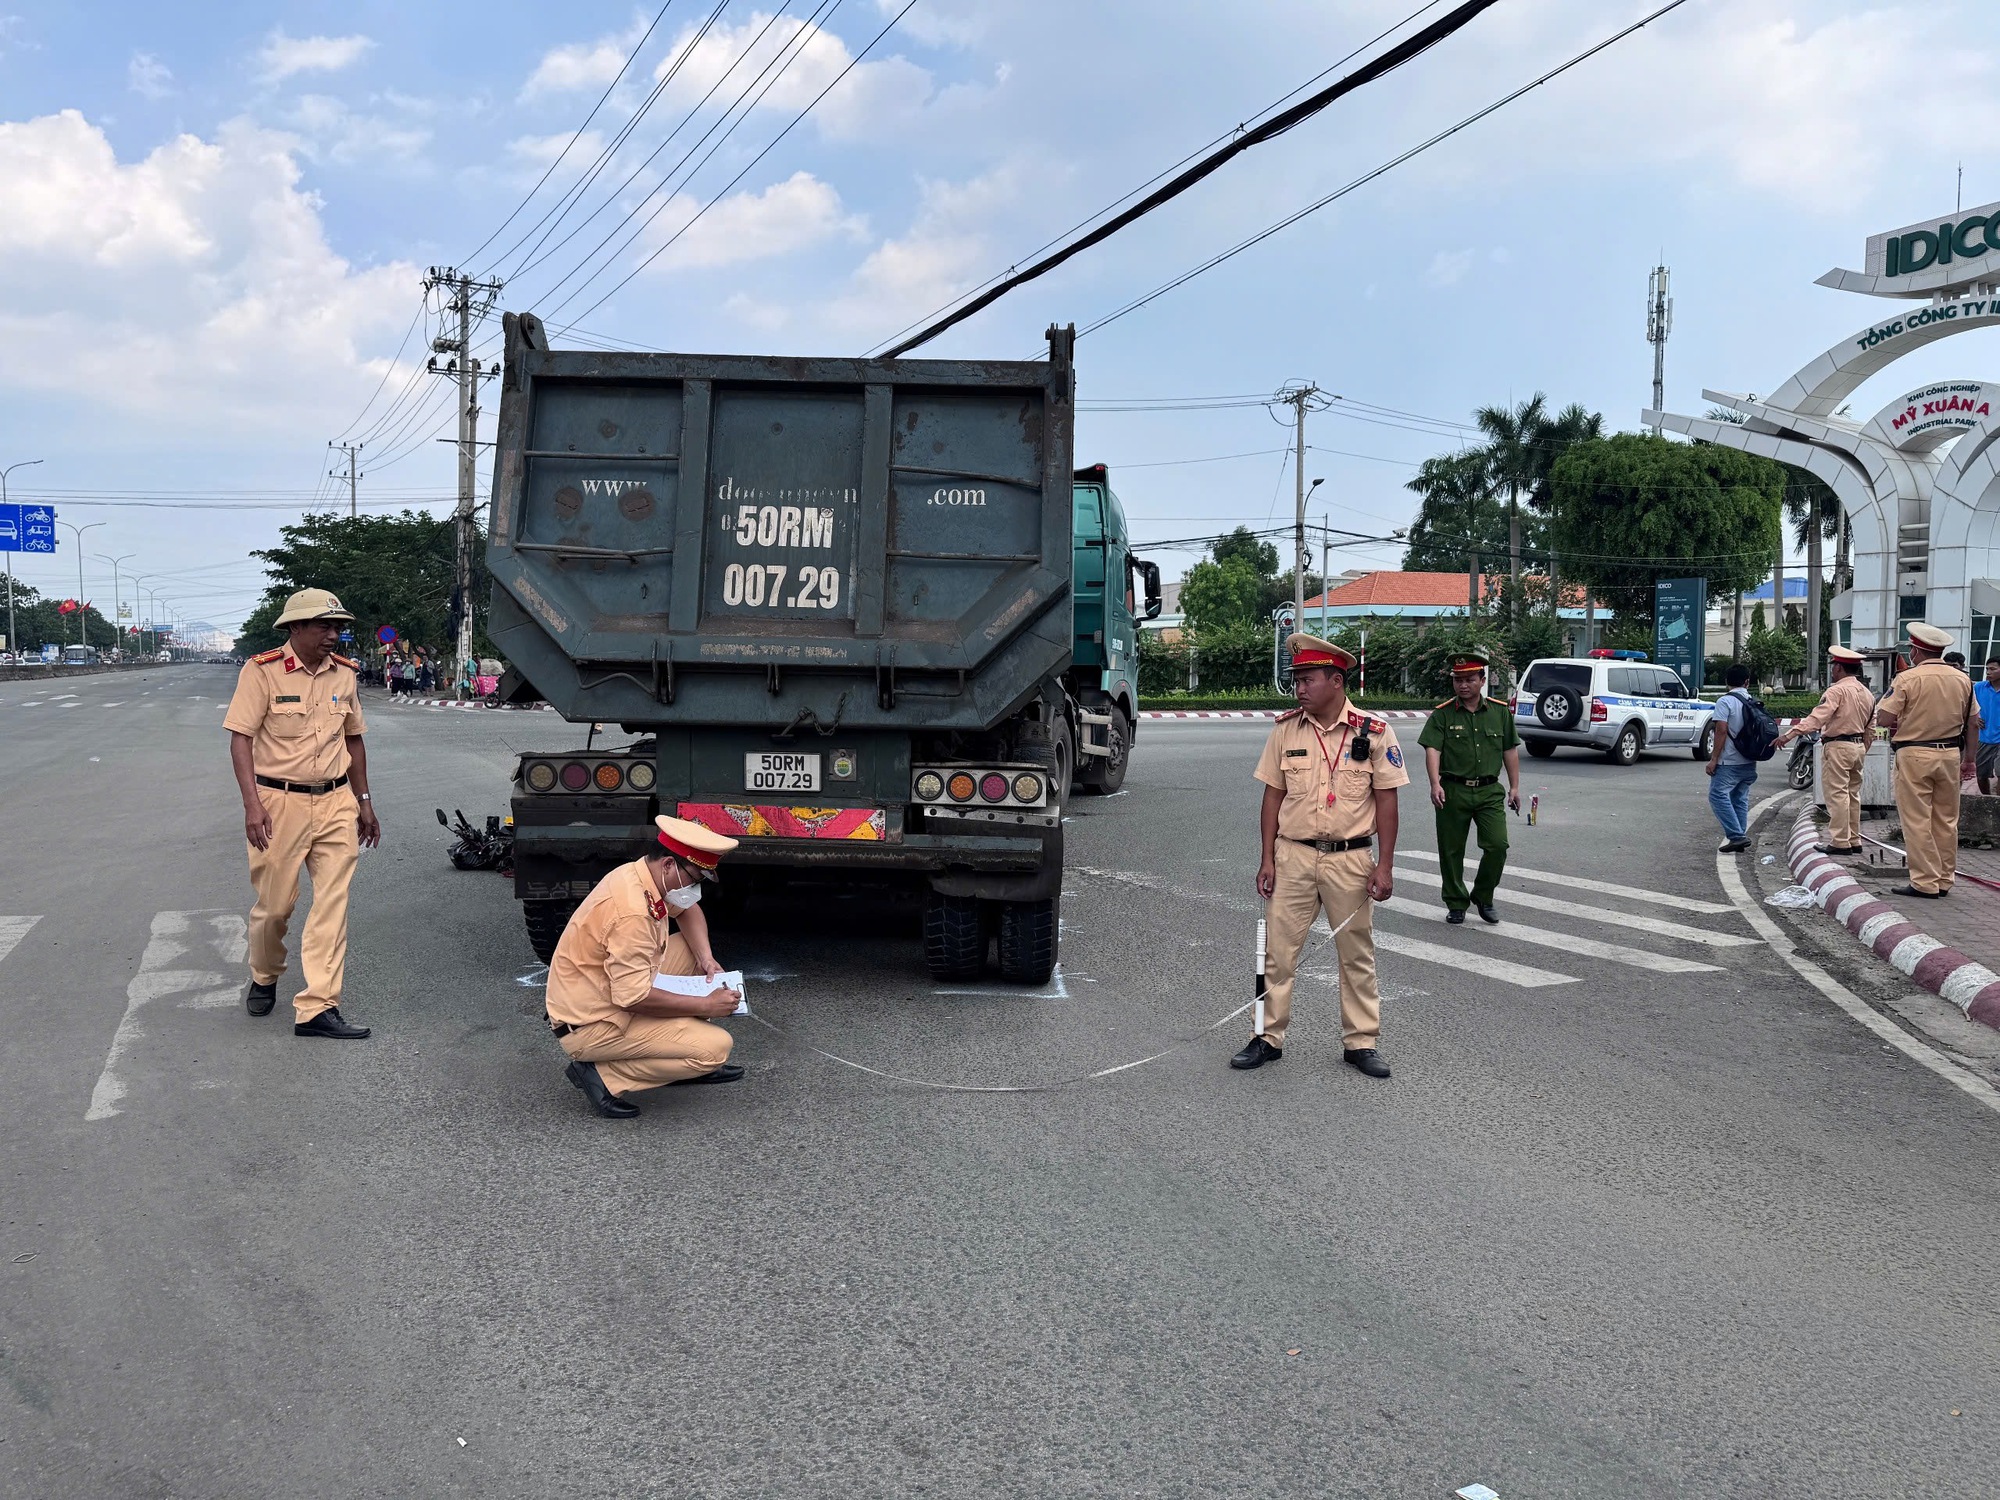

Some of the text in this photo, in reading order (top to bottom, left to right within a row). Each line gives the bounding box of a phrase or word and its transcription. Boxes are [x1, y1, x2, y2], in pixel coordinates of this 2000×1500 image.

[1857, 321, 1904, 350] TỔNG
[1906, 308, 1957, 329] CÔNG
[1962, 300, 1987, 316] TY
[1907, 384, 1981, 403] KHU CÔNG NGHIỆP
[1891, 395, 1990, 430] MỸ XUÂN A
[1907, 418, 1977, 436] INDUSTRIAL PARK
[926, 487, 987, 507] .com
[736, 505, 834, 549] 50RM
[723, 563, 840, 609] 007.29
[760, 754, 805, 772] 50RM
[753, 772, 813, 789] 007.29
